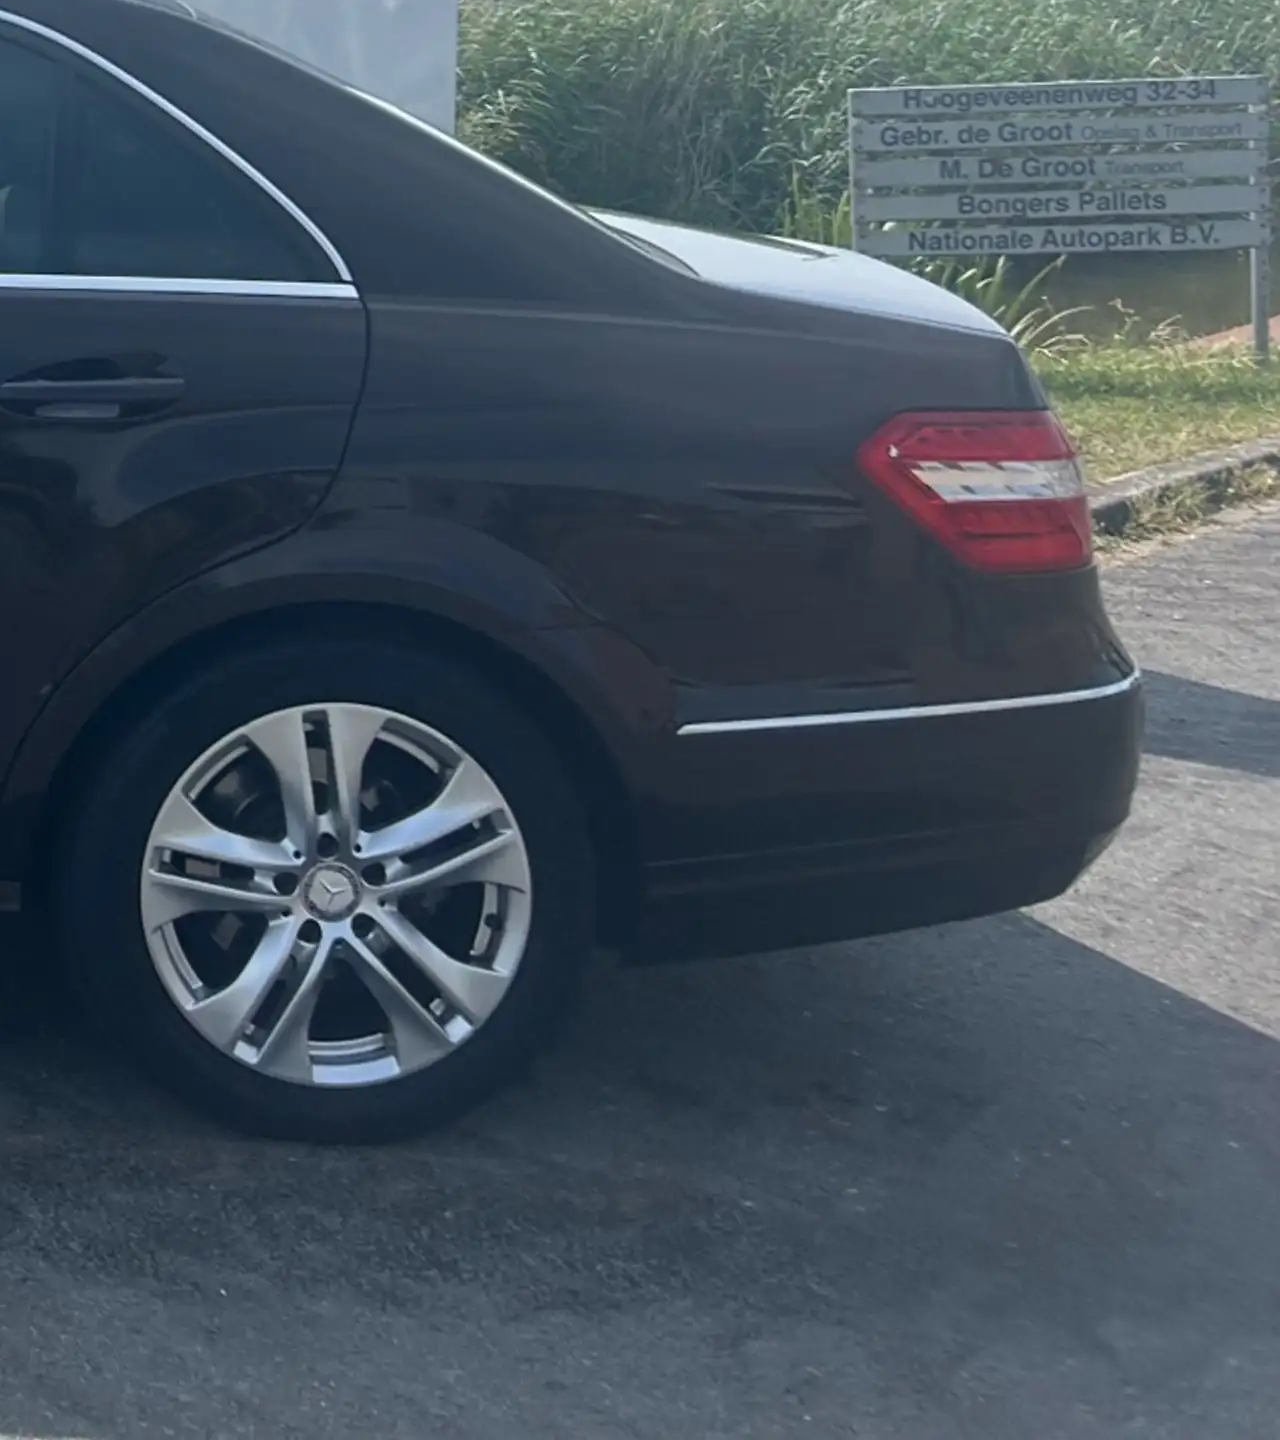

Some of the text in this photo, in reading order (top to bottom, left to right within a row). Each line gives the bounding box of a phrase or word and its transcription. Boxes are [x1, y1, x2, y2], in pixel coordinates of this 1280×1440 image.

[1146, 80, 1217, 102] 32-34
[880, 126, 949, 147] Gebr.
[957, 124, 990, 145] de
[997, 121, 1073, 143] Groot
[1145, 124, 1158, 139] &
[1163, 122, 1243, 138] Transport
[939, 160, 969, 179] M.
[978, 158, 1014, 179] De
[1021, 157, 1097, 178] Groot
[957, 191, 1167, 216] Bongers Pallets
[908, 223, 1221, 252] Nationale Autopark B.V.
